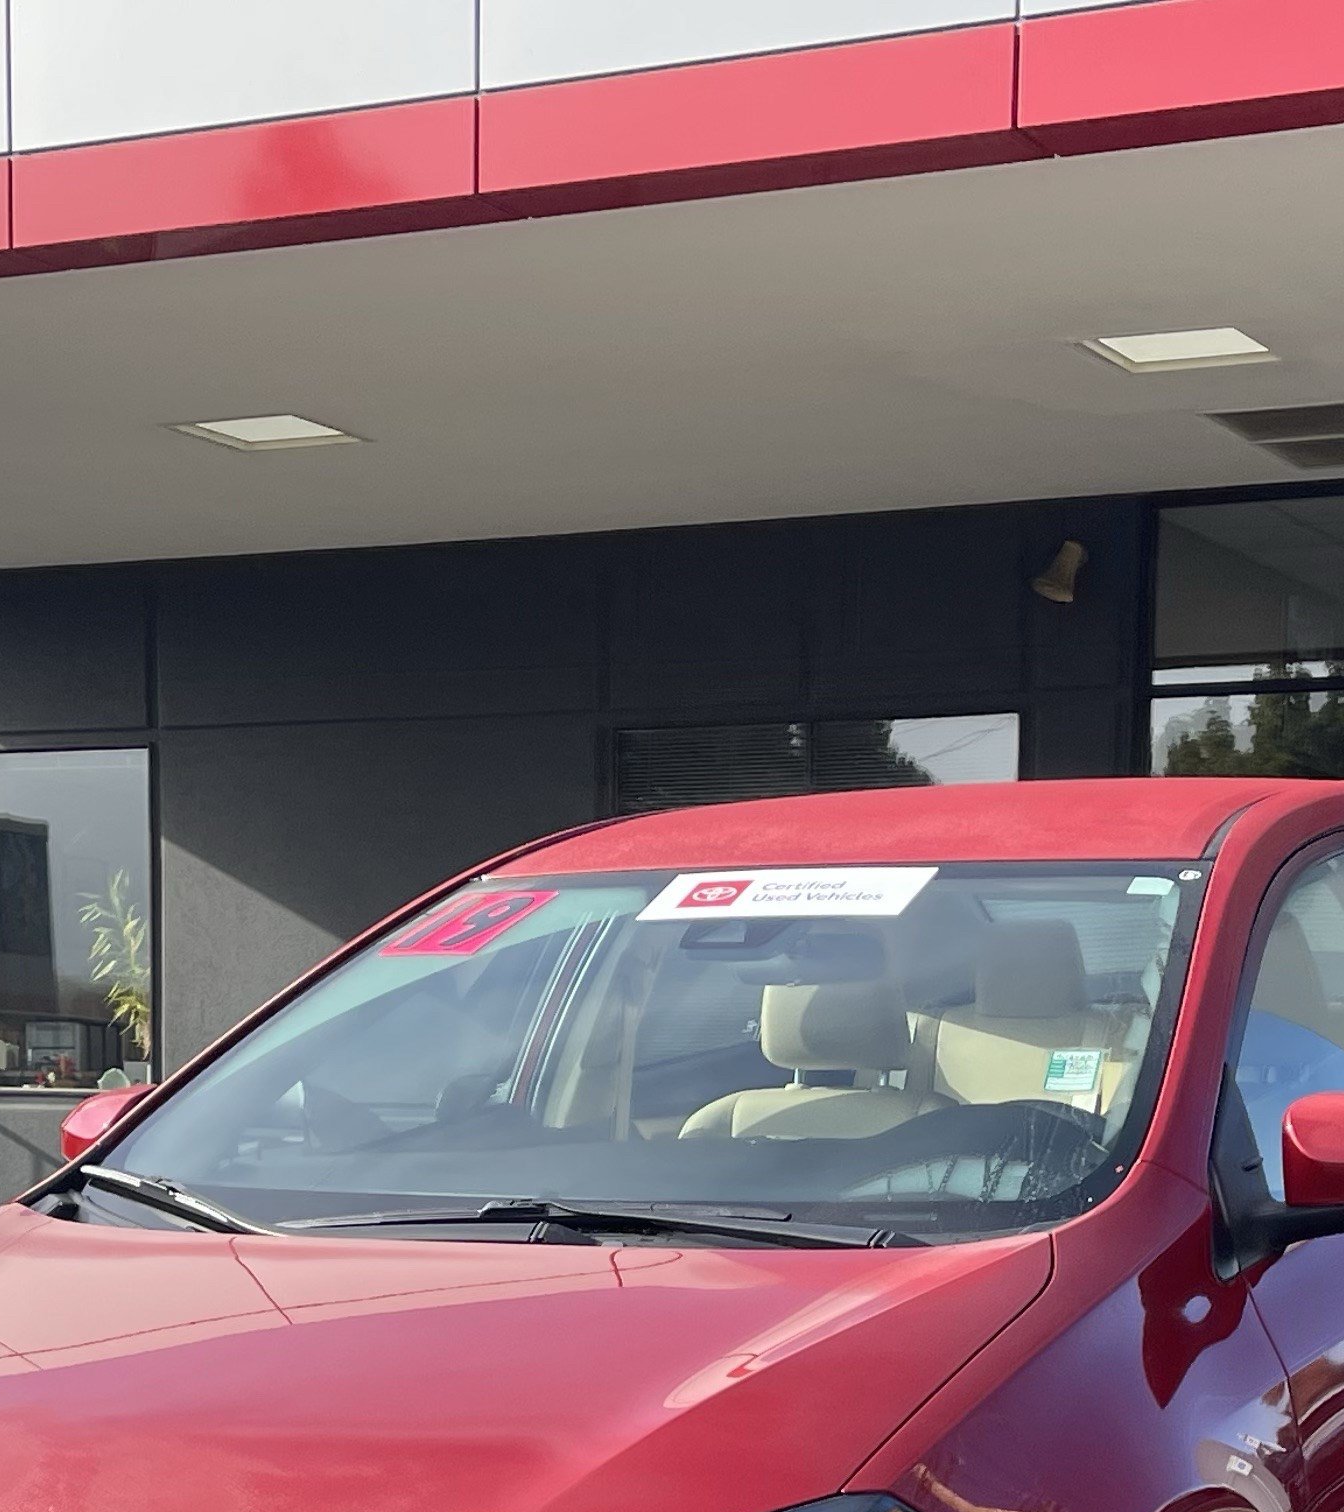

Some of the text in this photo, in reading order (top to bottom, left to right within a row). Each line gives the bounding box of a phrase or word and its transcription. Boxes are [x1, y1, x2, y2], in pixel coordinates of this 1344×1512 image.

[762, 880, 848, 891] Certified
[752, 891, 884, 902] Used Vehicles
[395, 896, 535, 948] 19
